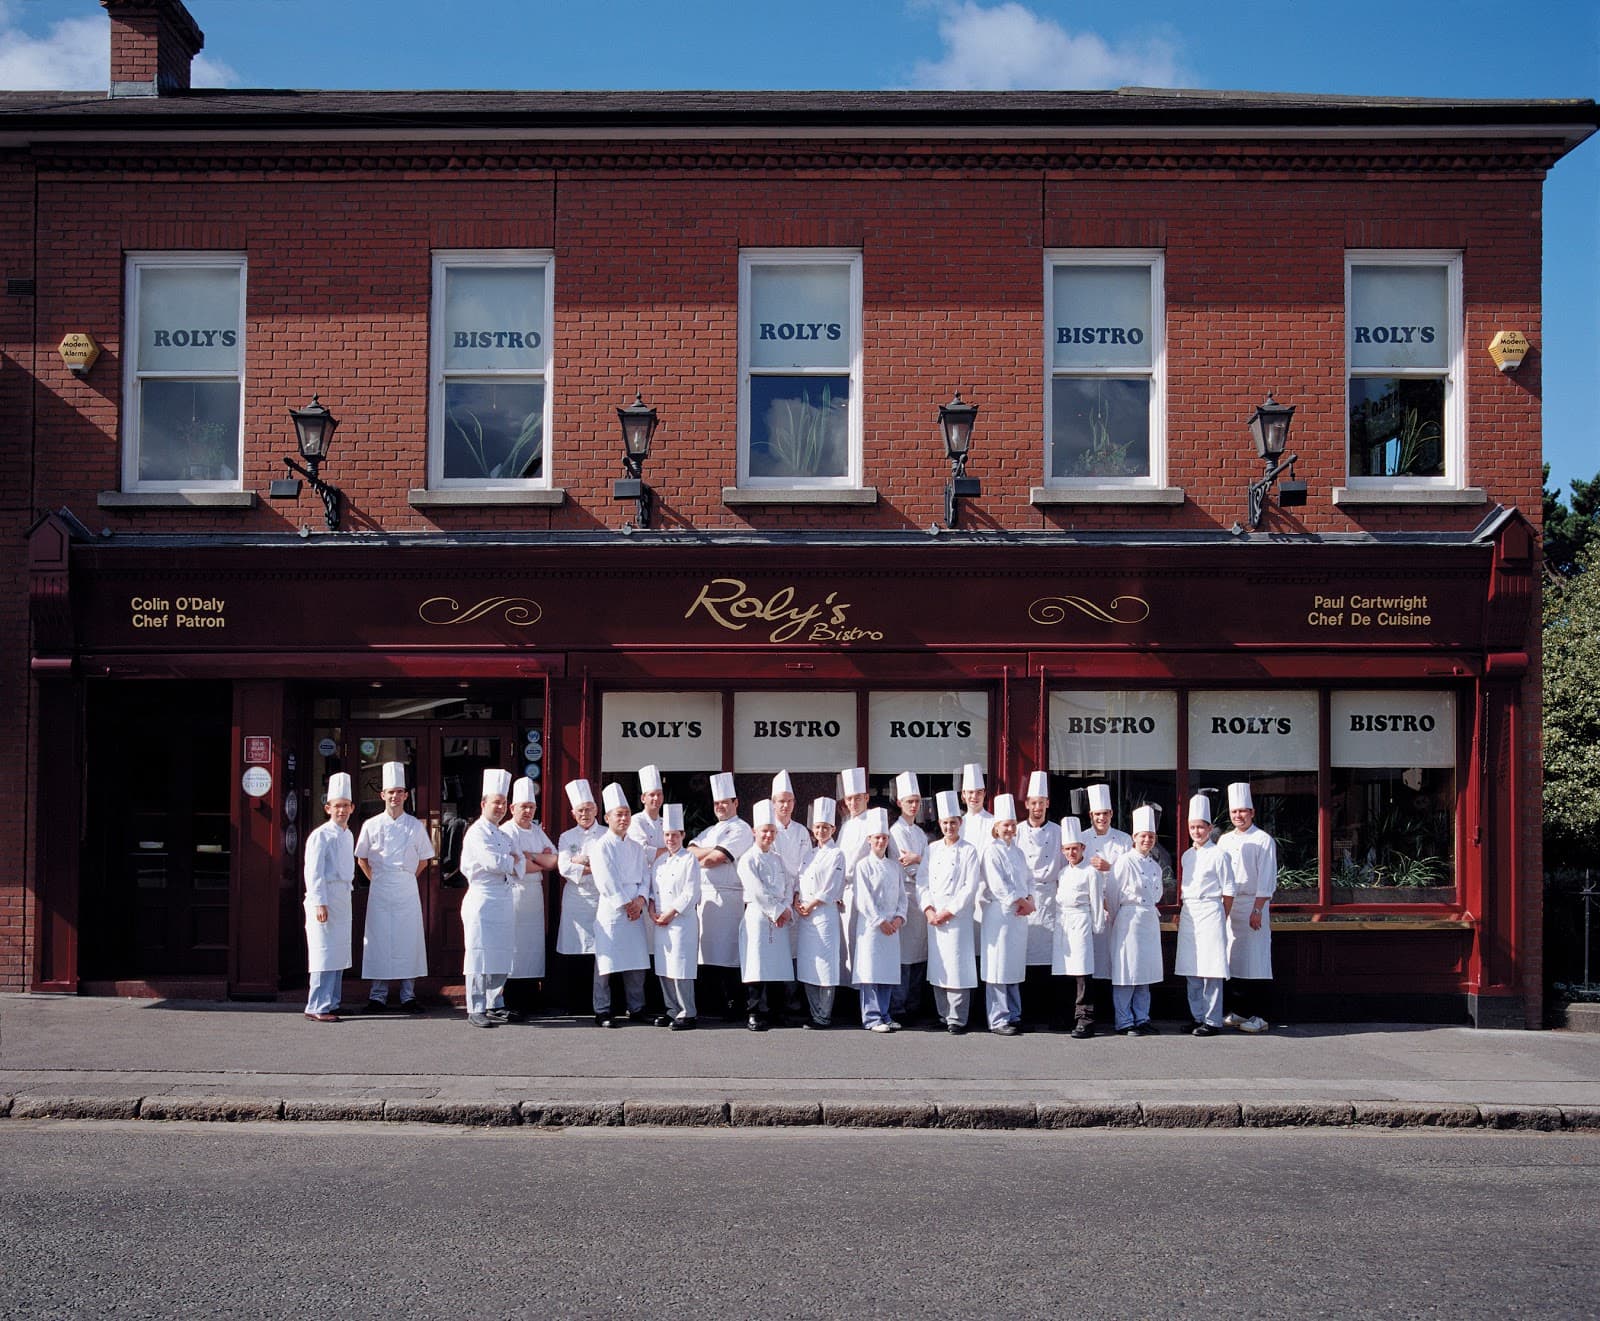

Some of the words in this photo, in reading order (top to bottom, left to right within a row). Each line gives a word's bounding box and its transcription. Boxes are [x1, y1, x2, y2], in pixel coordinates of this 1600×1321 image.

[154, 330, 235, 346] ROLY'S
[454, 332, 540, 348] BISTRO
[760, 324, 840, 340] ROLY'S
[1057, 328, 1143, 344] BISTRO
[1355, 327, 1434, 343] ROLY'S
[132, 598, 169, 610] Colin
[176, 598, 224, 612] O'Daly
[685, 579, 851, 643] Roly's
[1315, 596, 1344, 608] Paul
[1351, 596, 1427, 612] Cartwright
[133, 615, 168, 627] Chef
[177, 615, 224, 627] Patron
[1308, 612, 1343, 625] Chef
[1352, 613, 1370, 625] De
[1378, 613, 1430, 625] Cuisine
[807, 623, 884, 641] Bistro
[622, 722, 701, 737] ROLY'S
[754, 721, 840, 737] BISTRO
[890, 721, 970, 737] ROLY'S
[1068, 717, 1154, 733] BISTRO
[1212, 717, 1291, 734] ROLY'S
[1350, 715, 1435, 731] BISTRO
